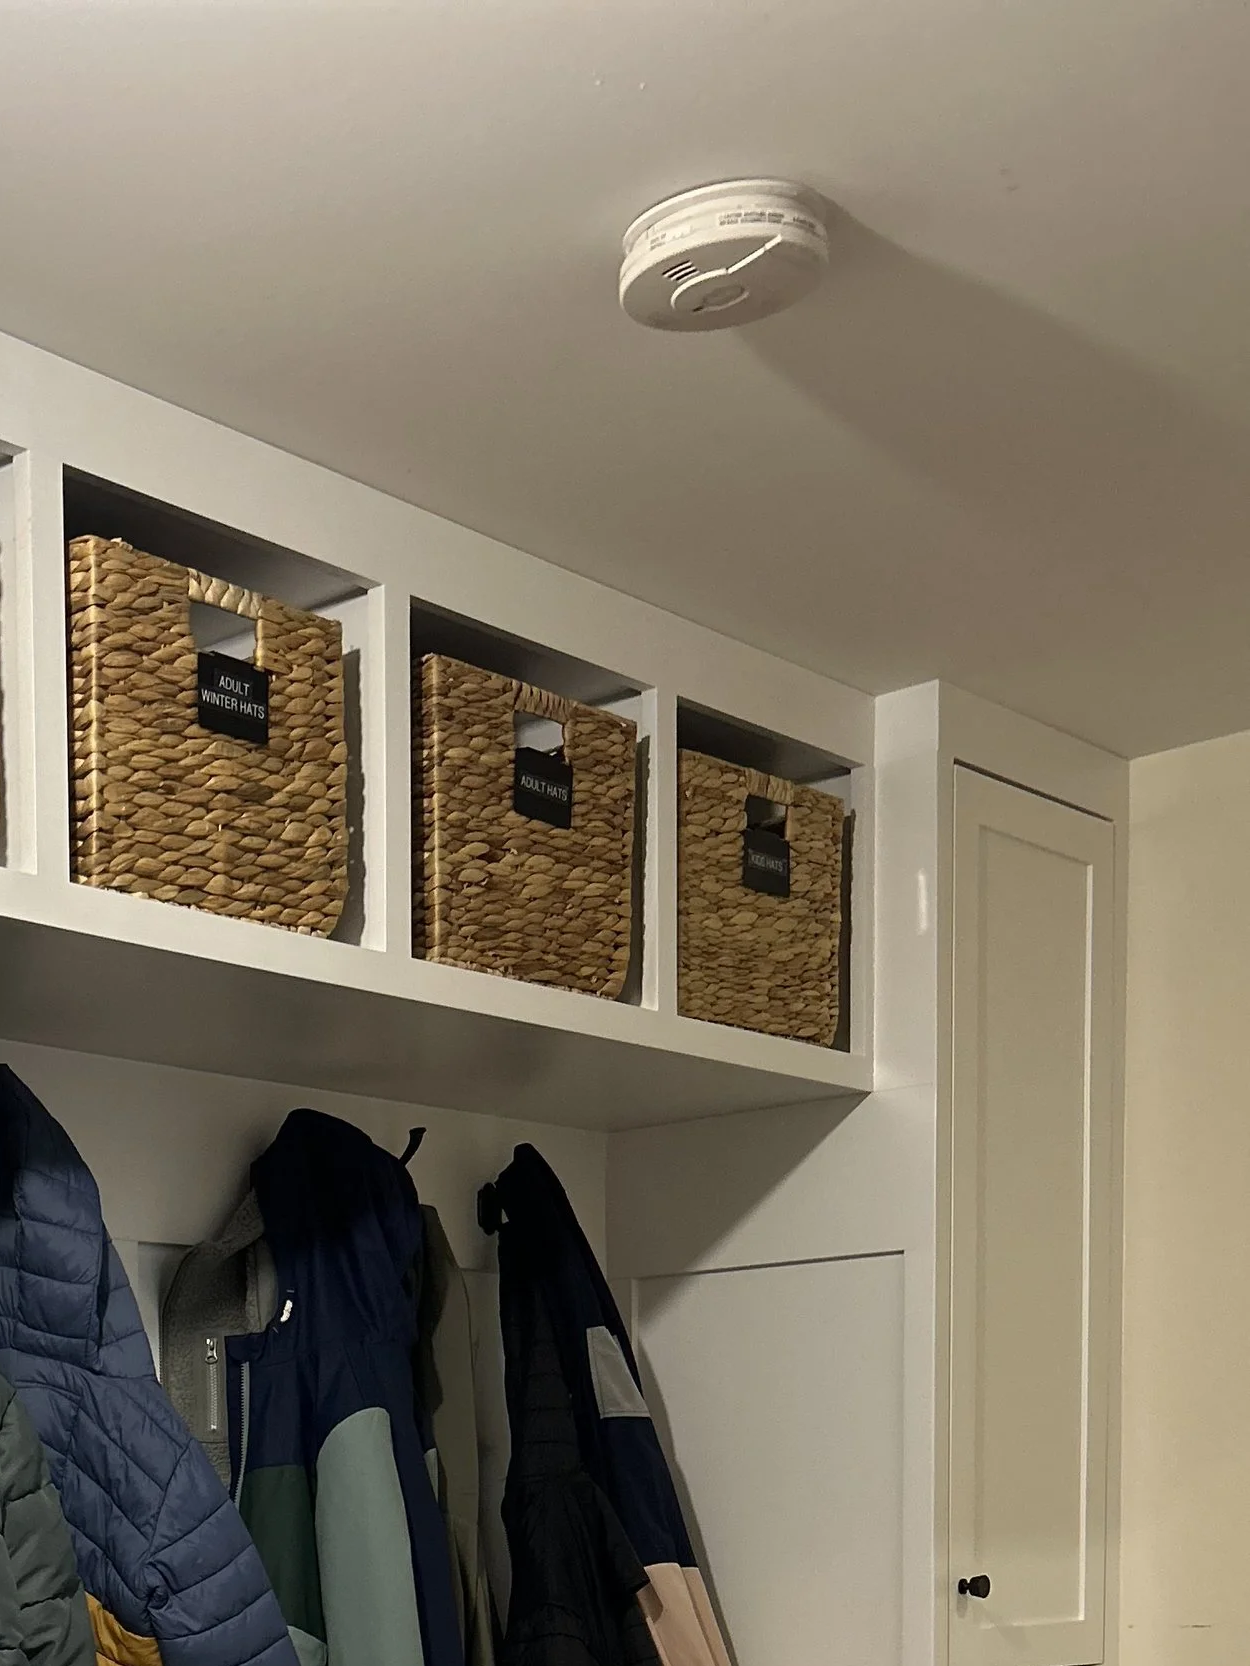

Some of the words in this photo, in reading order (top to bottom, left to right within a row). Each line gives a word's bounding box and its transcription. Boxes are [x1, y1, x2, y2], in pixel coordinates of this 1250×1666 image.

[218, 675, 250, 696] ADULT
[201, 688, 238, 711] WINTER
[239, 700, 265, 719] HATS
[520, 775, 546, 794] ADULT
[547, 784, 568, 801] HATS
